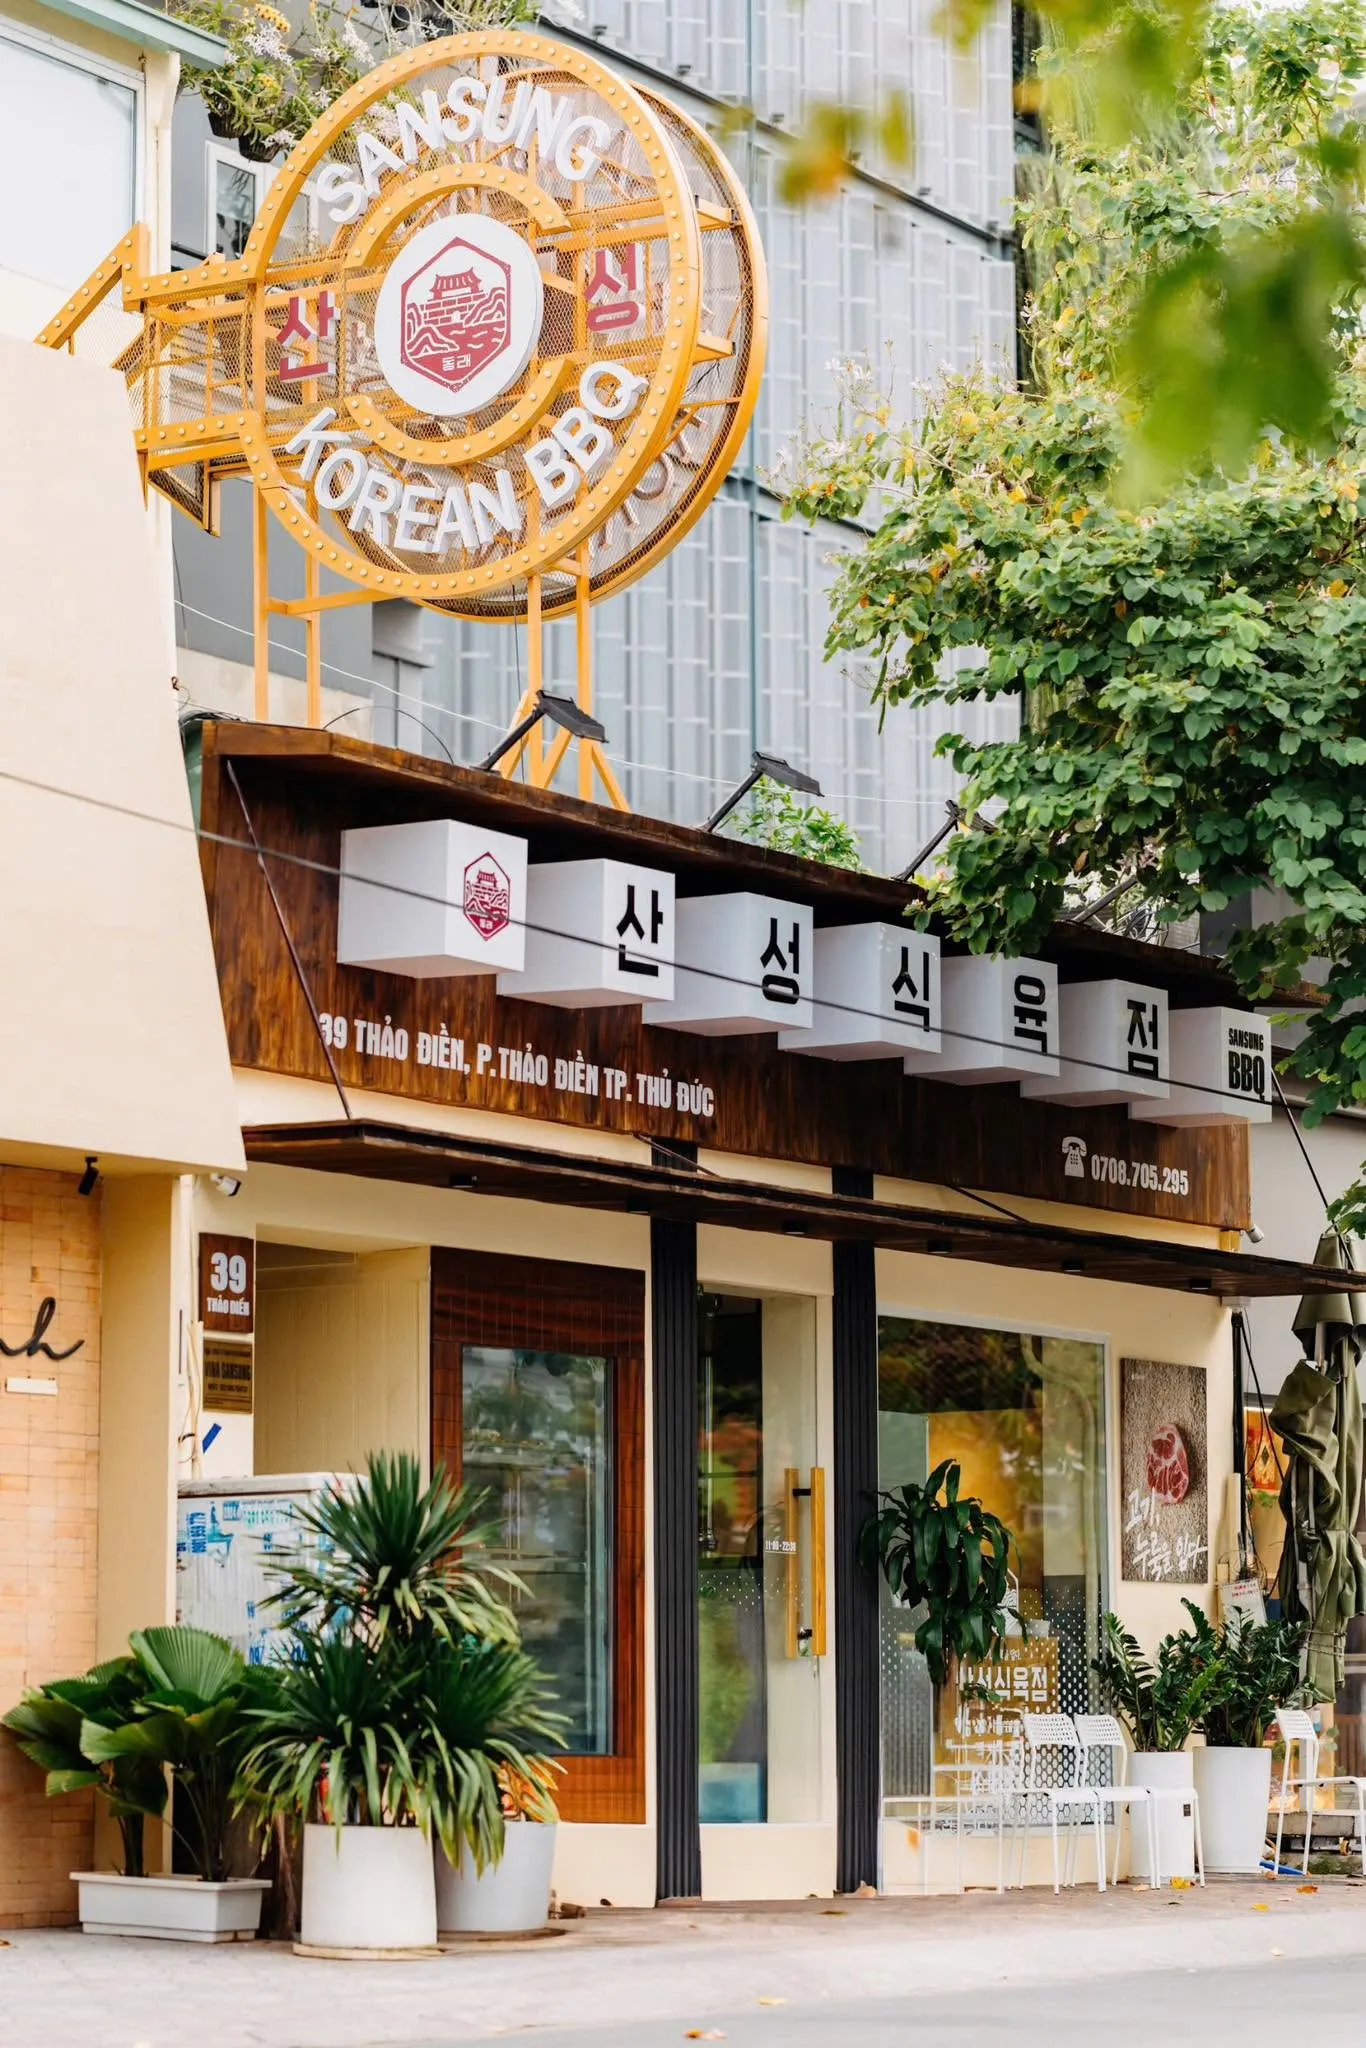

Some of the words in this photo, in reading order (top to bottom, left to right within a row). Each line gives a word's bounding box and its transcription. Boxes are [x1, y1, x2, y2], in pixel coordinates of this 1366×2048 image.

[316, 76, 611, 224] SANSUNG
[275, 291, 341, 383] 산
[585, 242, 646, 333] 성
[442, 353, 471, 372] 동래
[285, 407, 523, 554] KOREAN
[523, 361, 651, 508] BBQ
[616, 884, 664, 977] 산
[760, 917, 800, 1005] 성
[891, 946, 930, 1032] 식
[1014, 974, 1048, 1054] 육
[1127, 999, 1159, 1079] 점
[318, 1012, 348, 1050] 39
[353, 1014, 410, 1062] THẢO
[554, 1049, 599, 1097] ĐIỀN
[603, 1067, 633, 1103] TP.
[636, 1067, 673, 1109] THỦ
[676, 1078, 715, 1118] ĐỨC
[1228, 1027, 1265, 1052] SANSUNG
[1228, 1050, 1266, 1101] BBQ
[1090, 1153, 1189, 1197] 0708.705.295
[210, 1252, 247, 1294] 39
